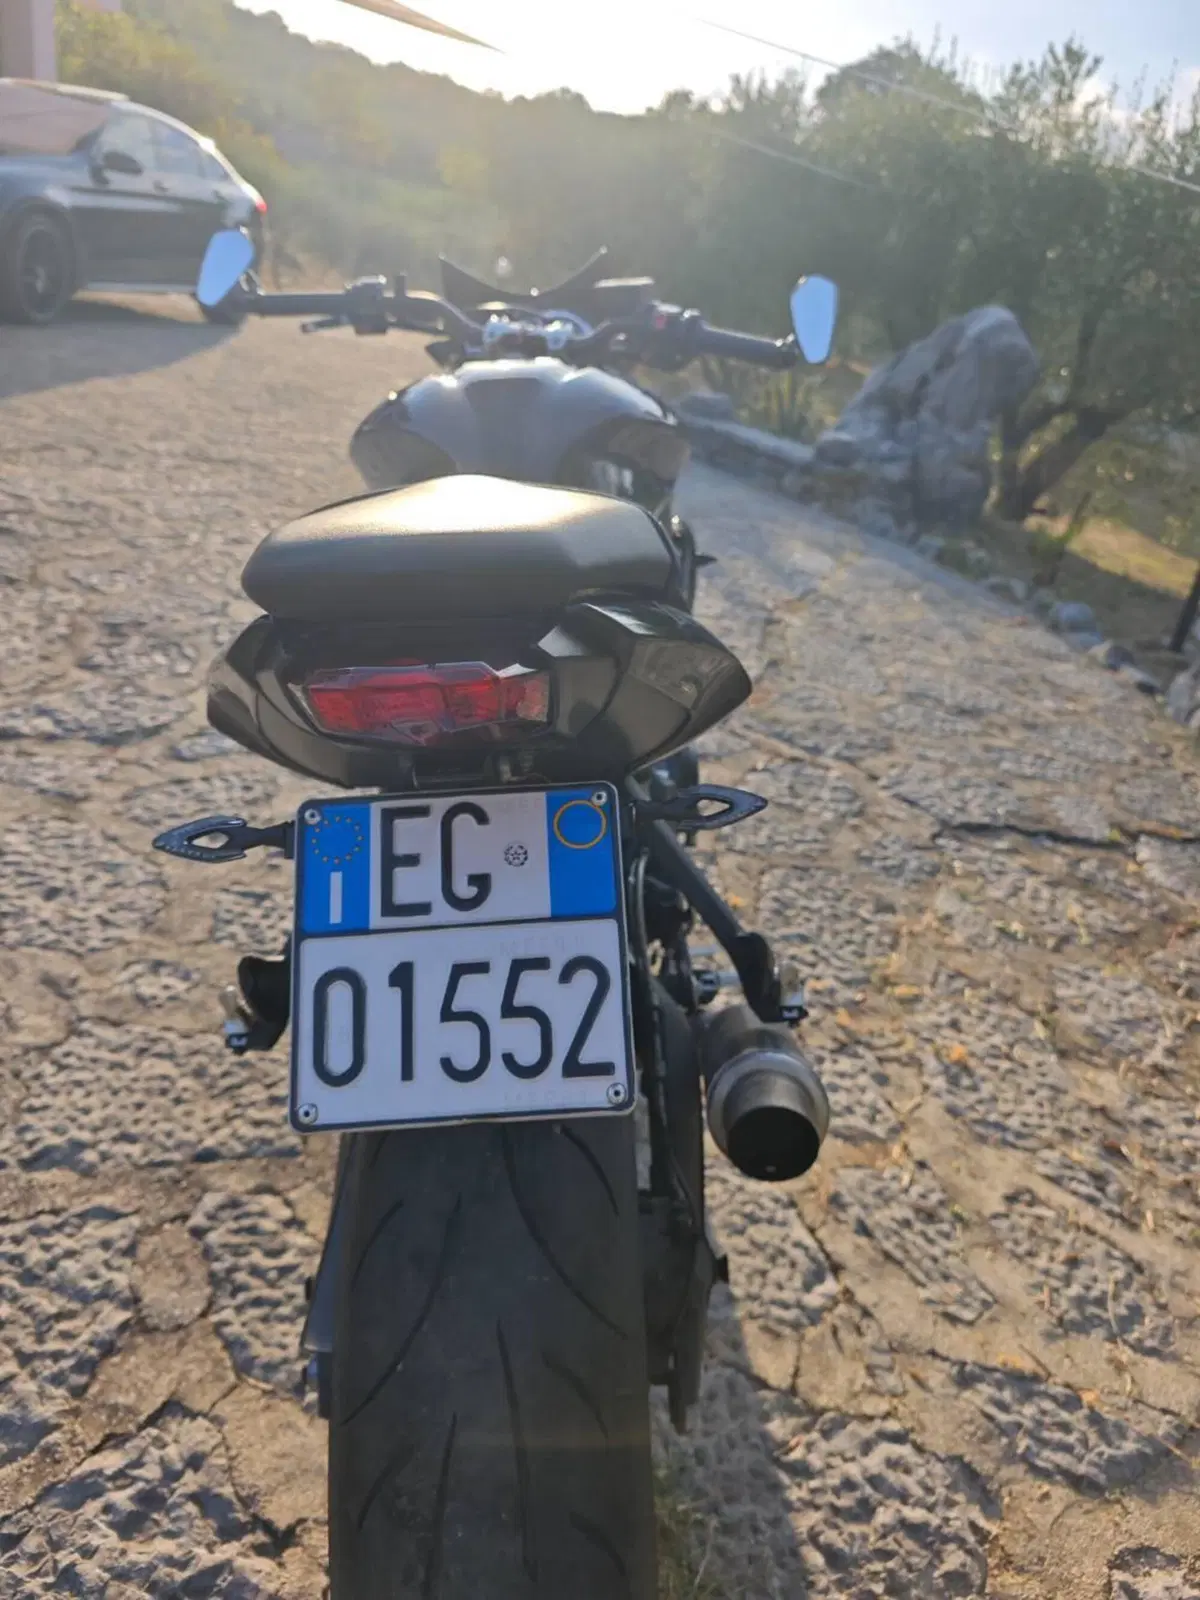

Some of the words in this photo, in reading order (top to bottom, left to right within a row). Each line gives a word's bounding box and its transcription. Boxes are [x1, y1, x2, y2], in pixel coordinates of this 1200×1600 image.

[329, 871, 343, 924] I
[380, 801, 492, 917] EG
[313, 955, 616, 1087] 01552
